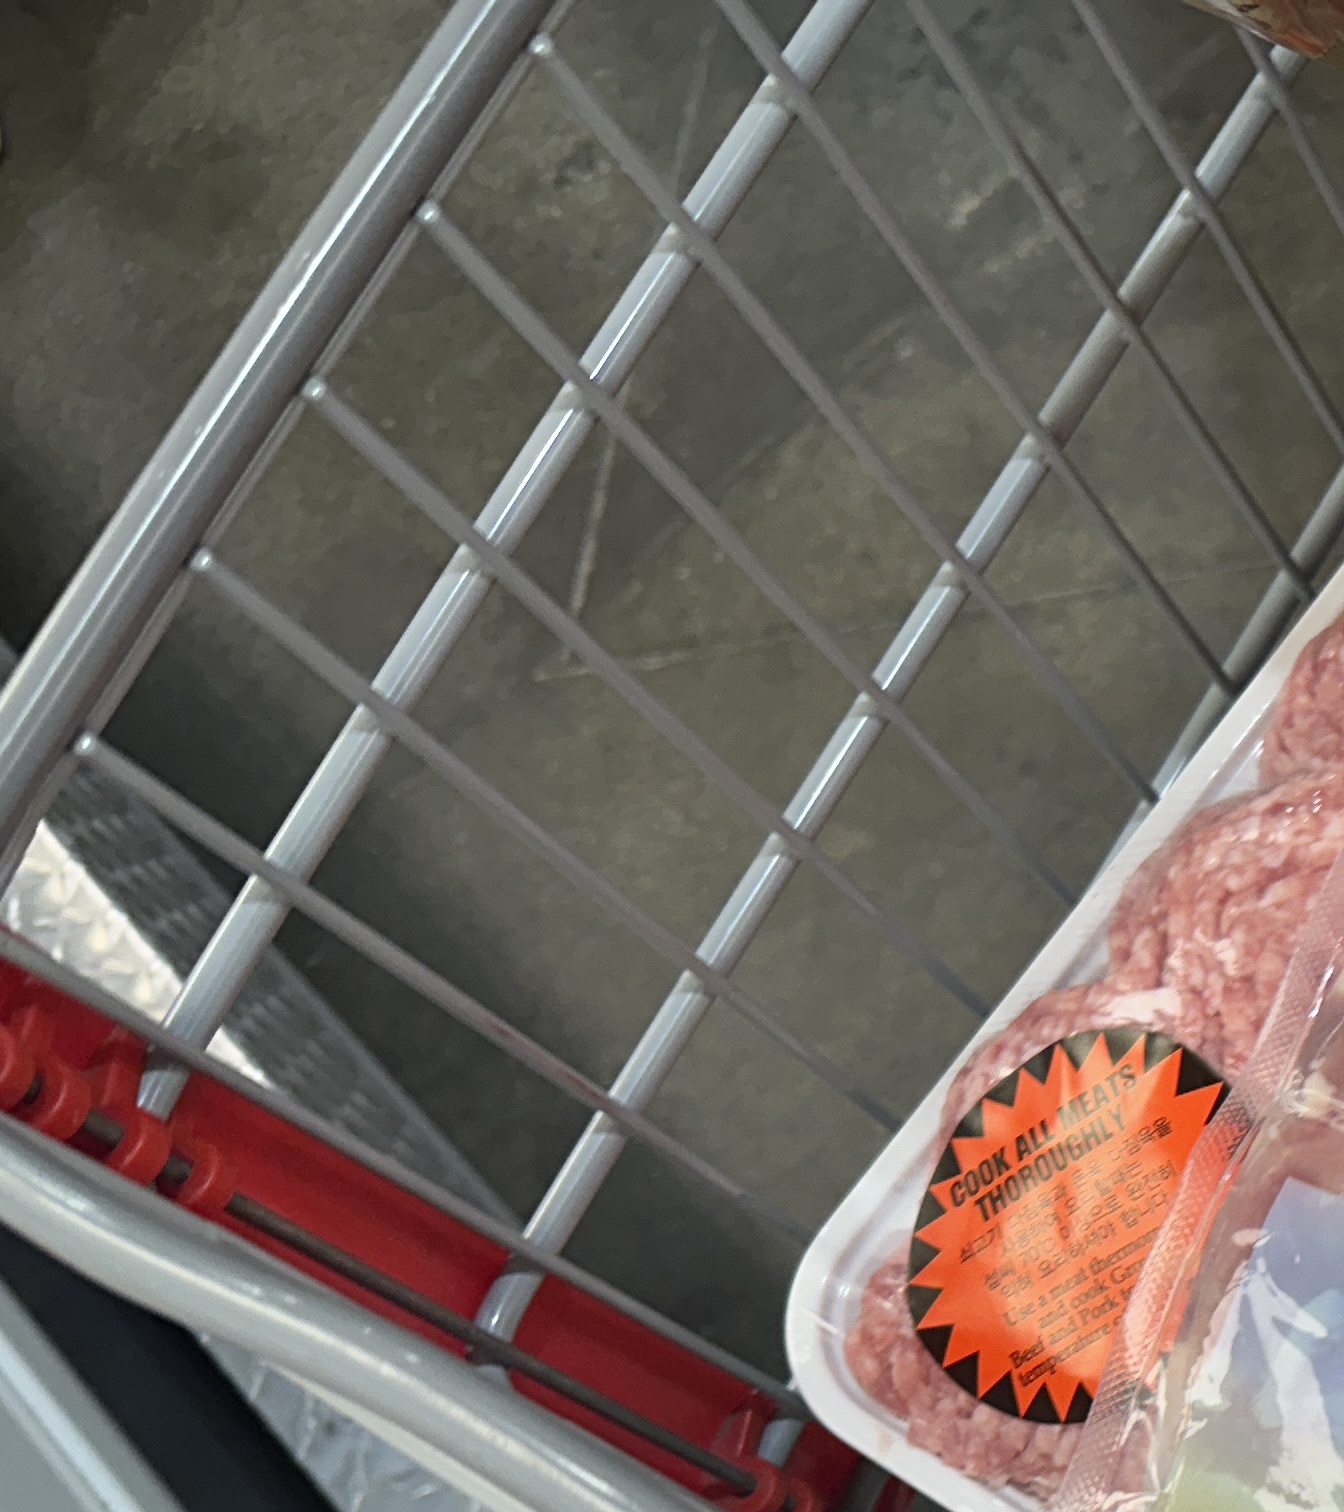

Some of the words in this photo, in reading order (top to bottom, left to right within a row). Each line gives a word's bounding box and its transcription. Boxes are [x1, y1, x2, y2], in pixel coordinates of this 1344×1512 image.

[950, 1145, 1012, 1208] COOK
[1014, 1118, 1054, 1163] ALL
[1056, 1062, 1139, 1133] MEATS
[974, 1105, 1128, 1223] THOROUGHLY
[1008, 1337, 1047, 1371] Beef
[1078, 1291, 1121, 1330] Pork
[1047, 1266, 1091, 1299] meat
